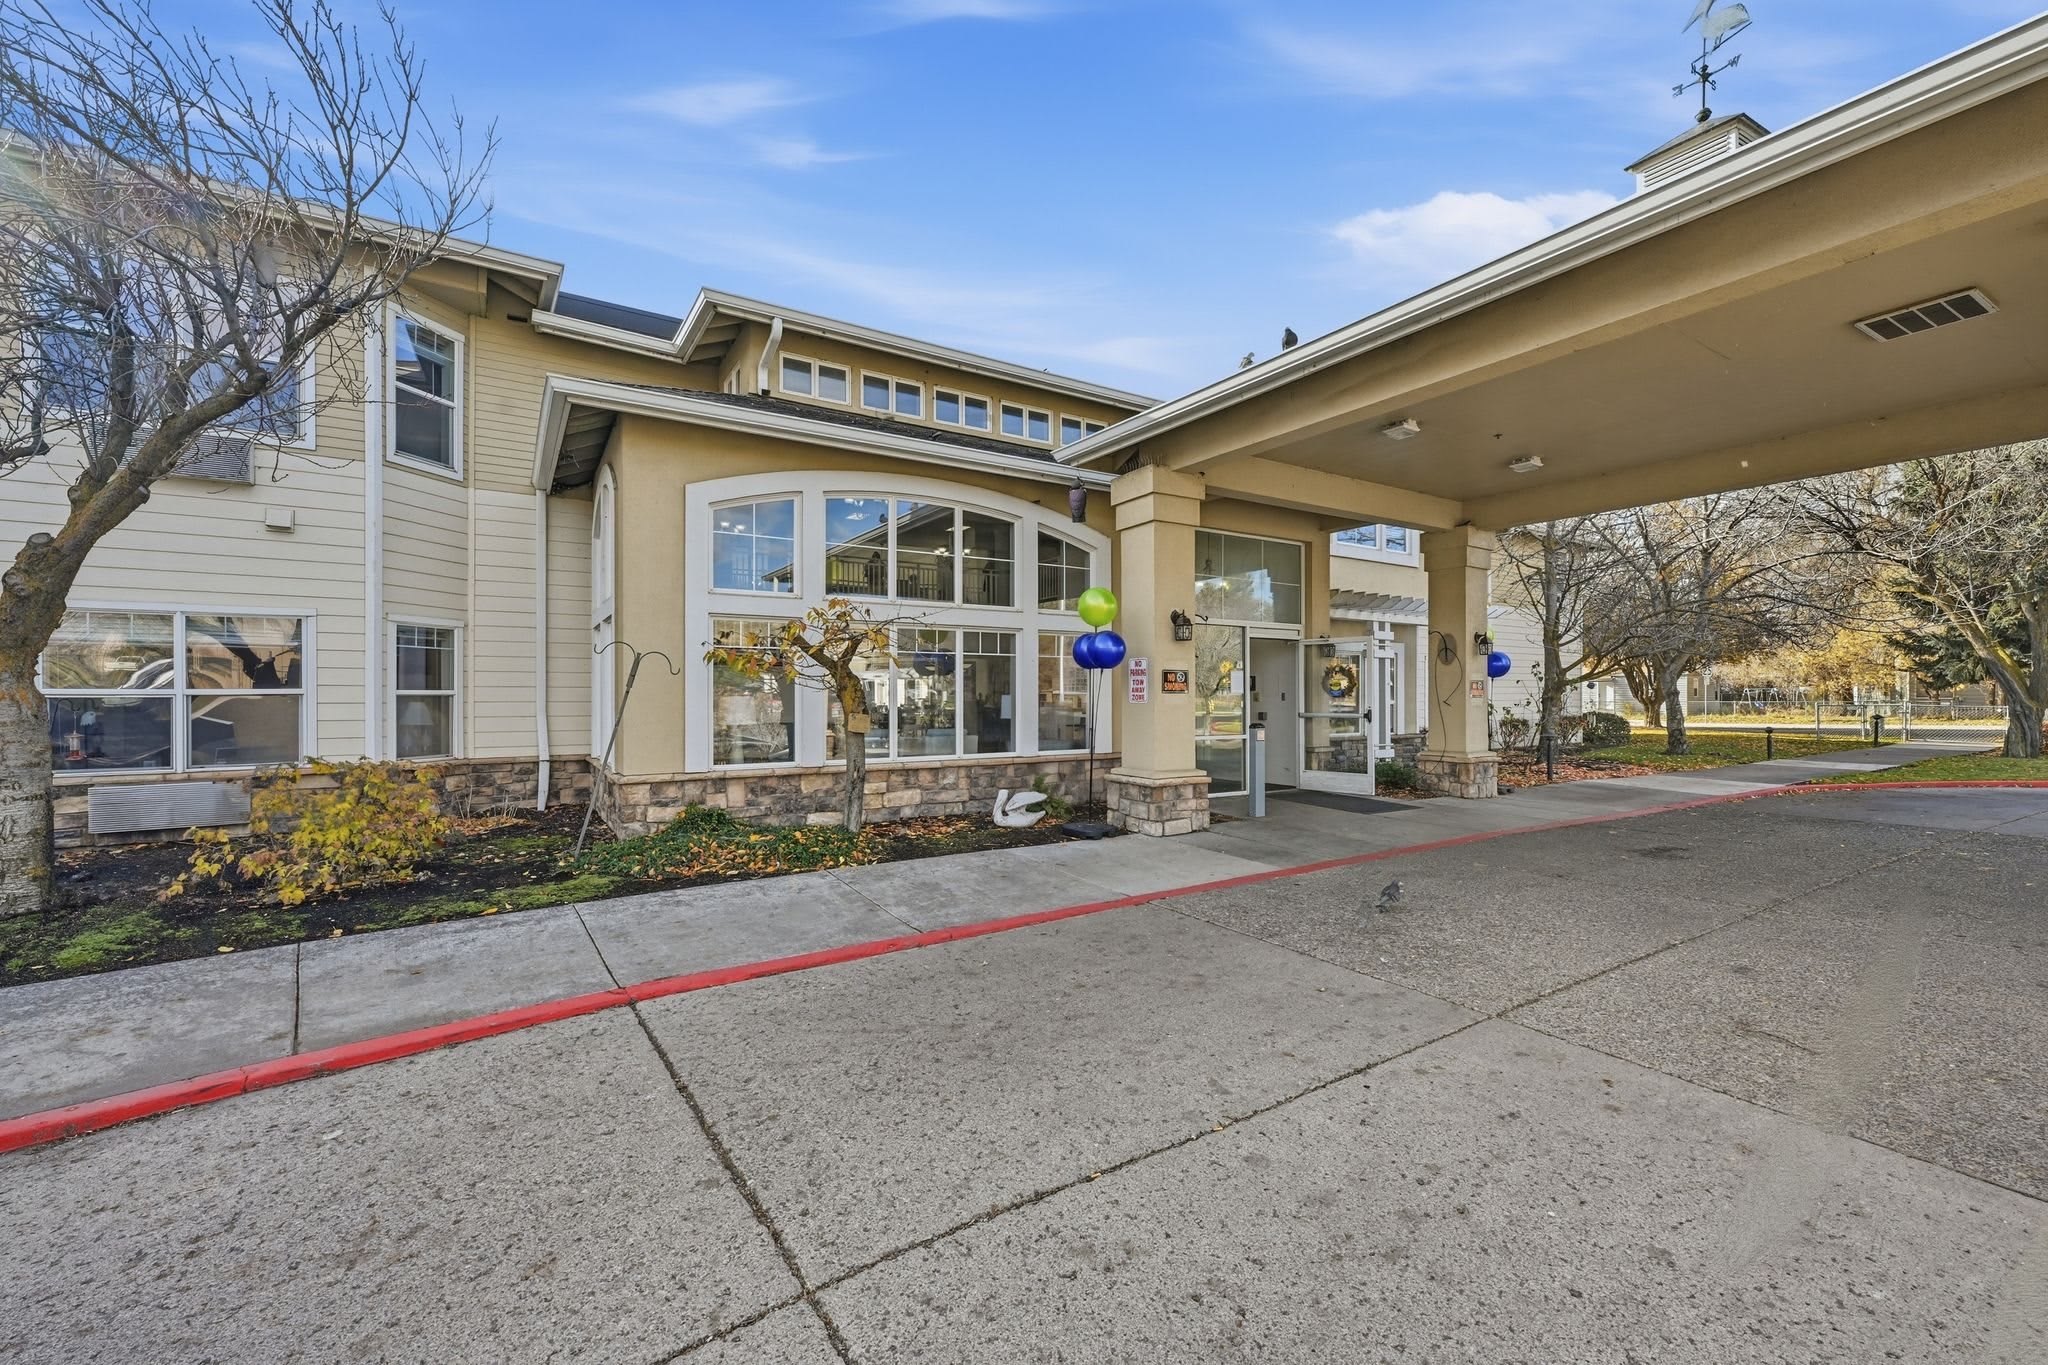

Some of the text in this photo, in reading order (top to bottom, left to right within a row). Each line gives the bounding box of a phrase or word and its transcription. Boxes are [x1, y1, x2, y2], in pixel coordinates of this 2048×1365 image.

[1135, 660, 1142, 668] NO
[1130, 668, 1147, 677] PARKING
[1167, 673, 1176, 682] NO
